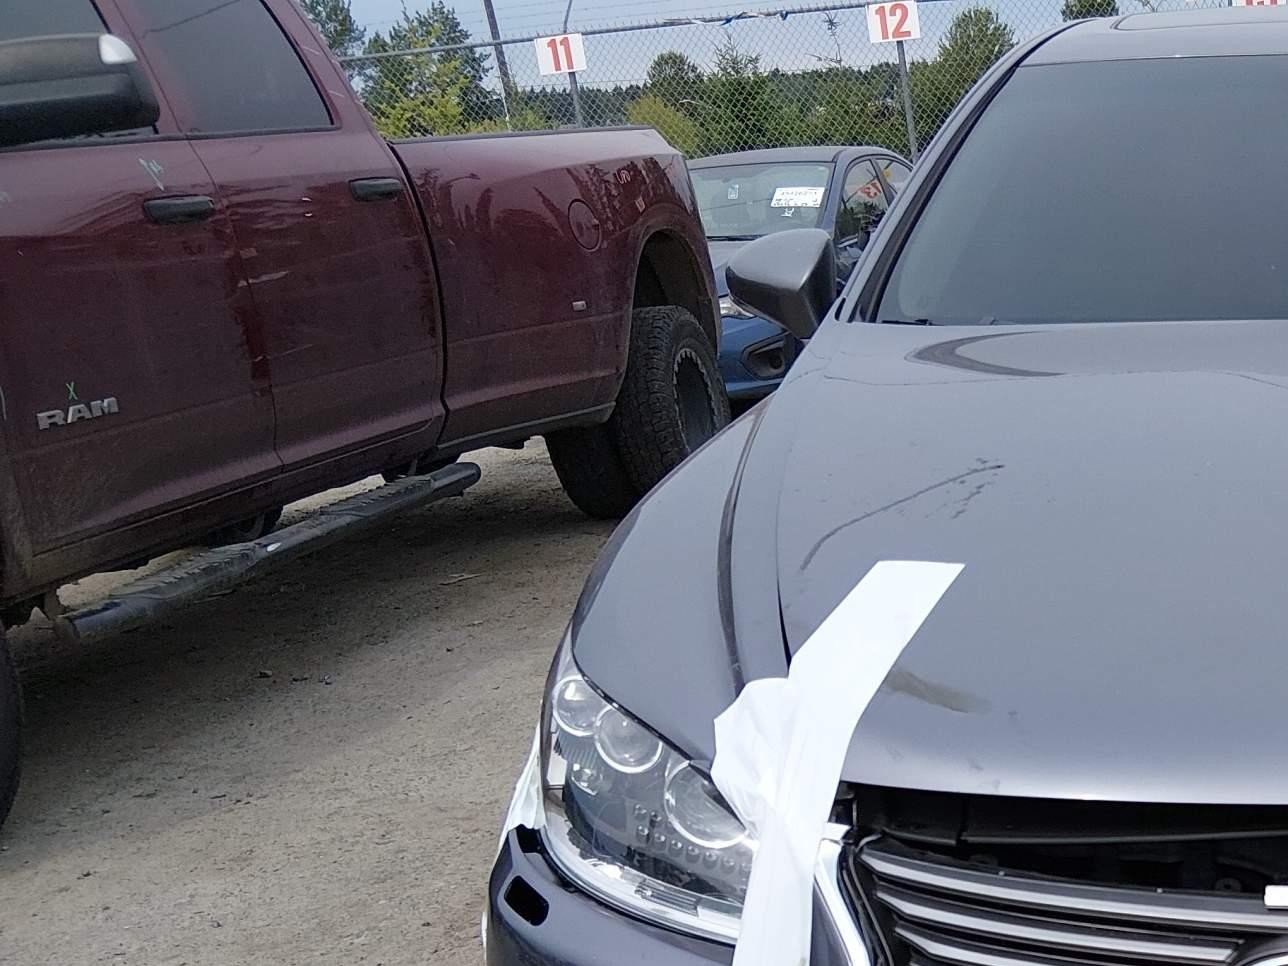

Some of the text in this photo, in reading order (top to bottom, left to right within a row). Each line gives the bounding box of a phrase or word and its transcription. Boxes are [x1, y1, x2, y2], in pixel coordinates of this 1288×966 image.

[875, 3, 912, 40] 12
[547, 36, 575, 72] 11
[36, 397, 119, 430] RAM
